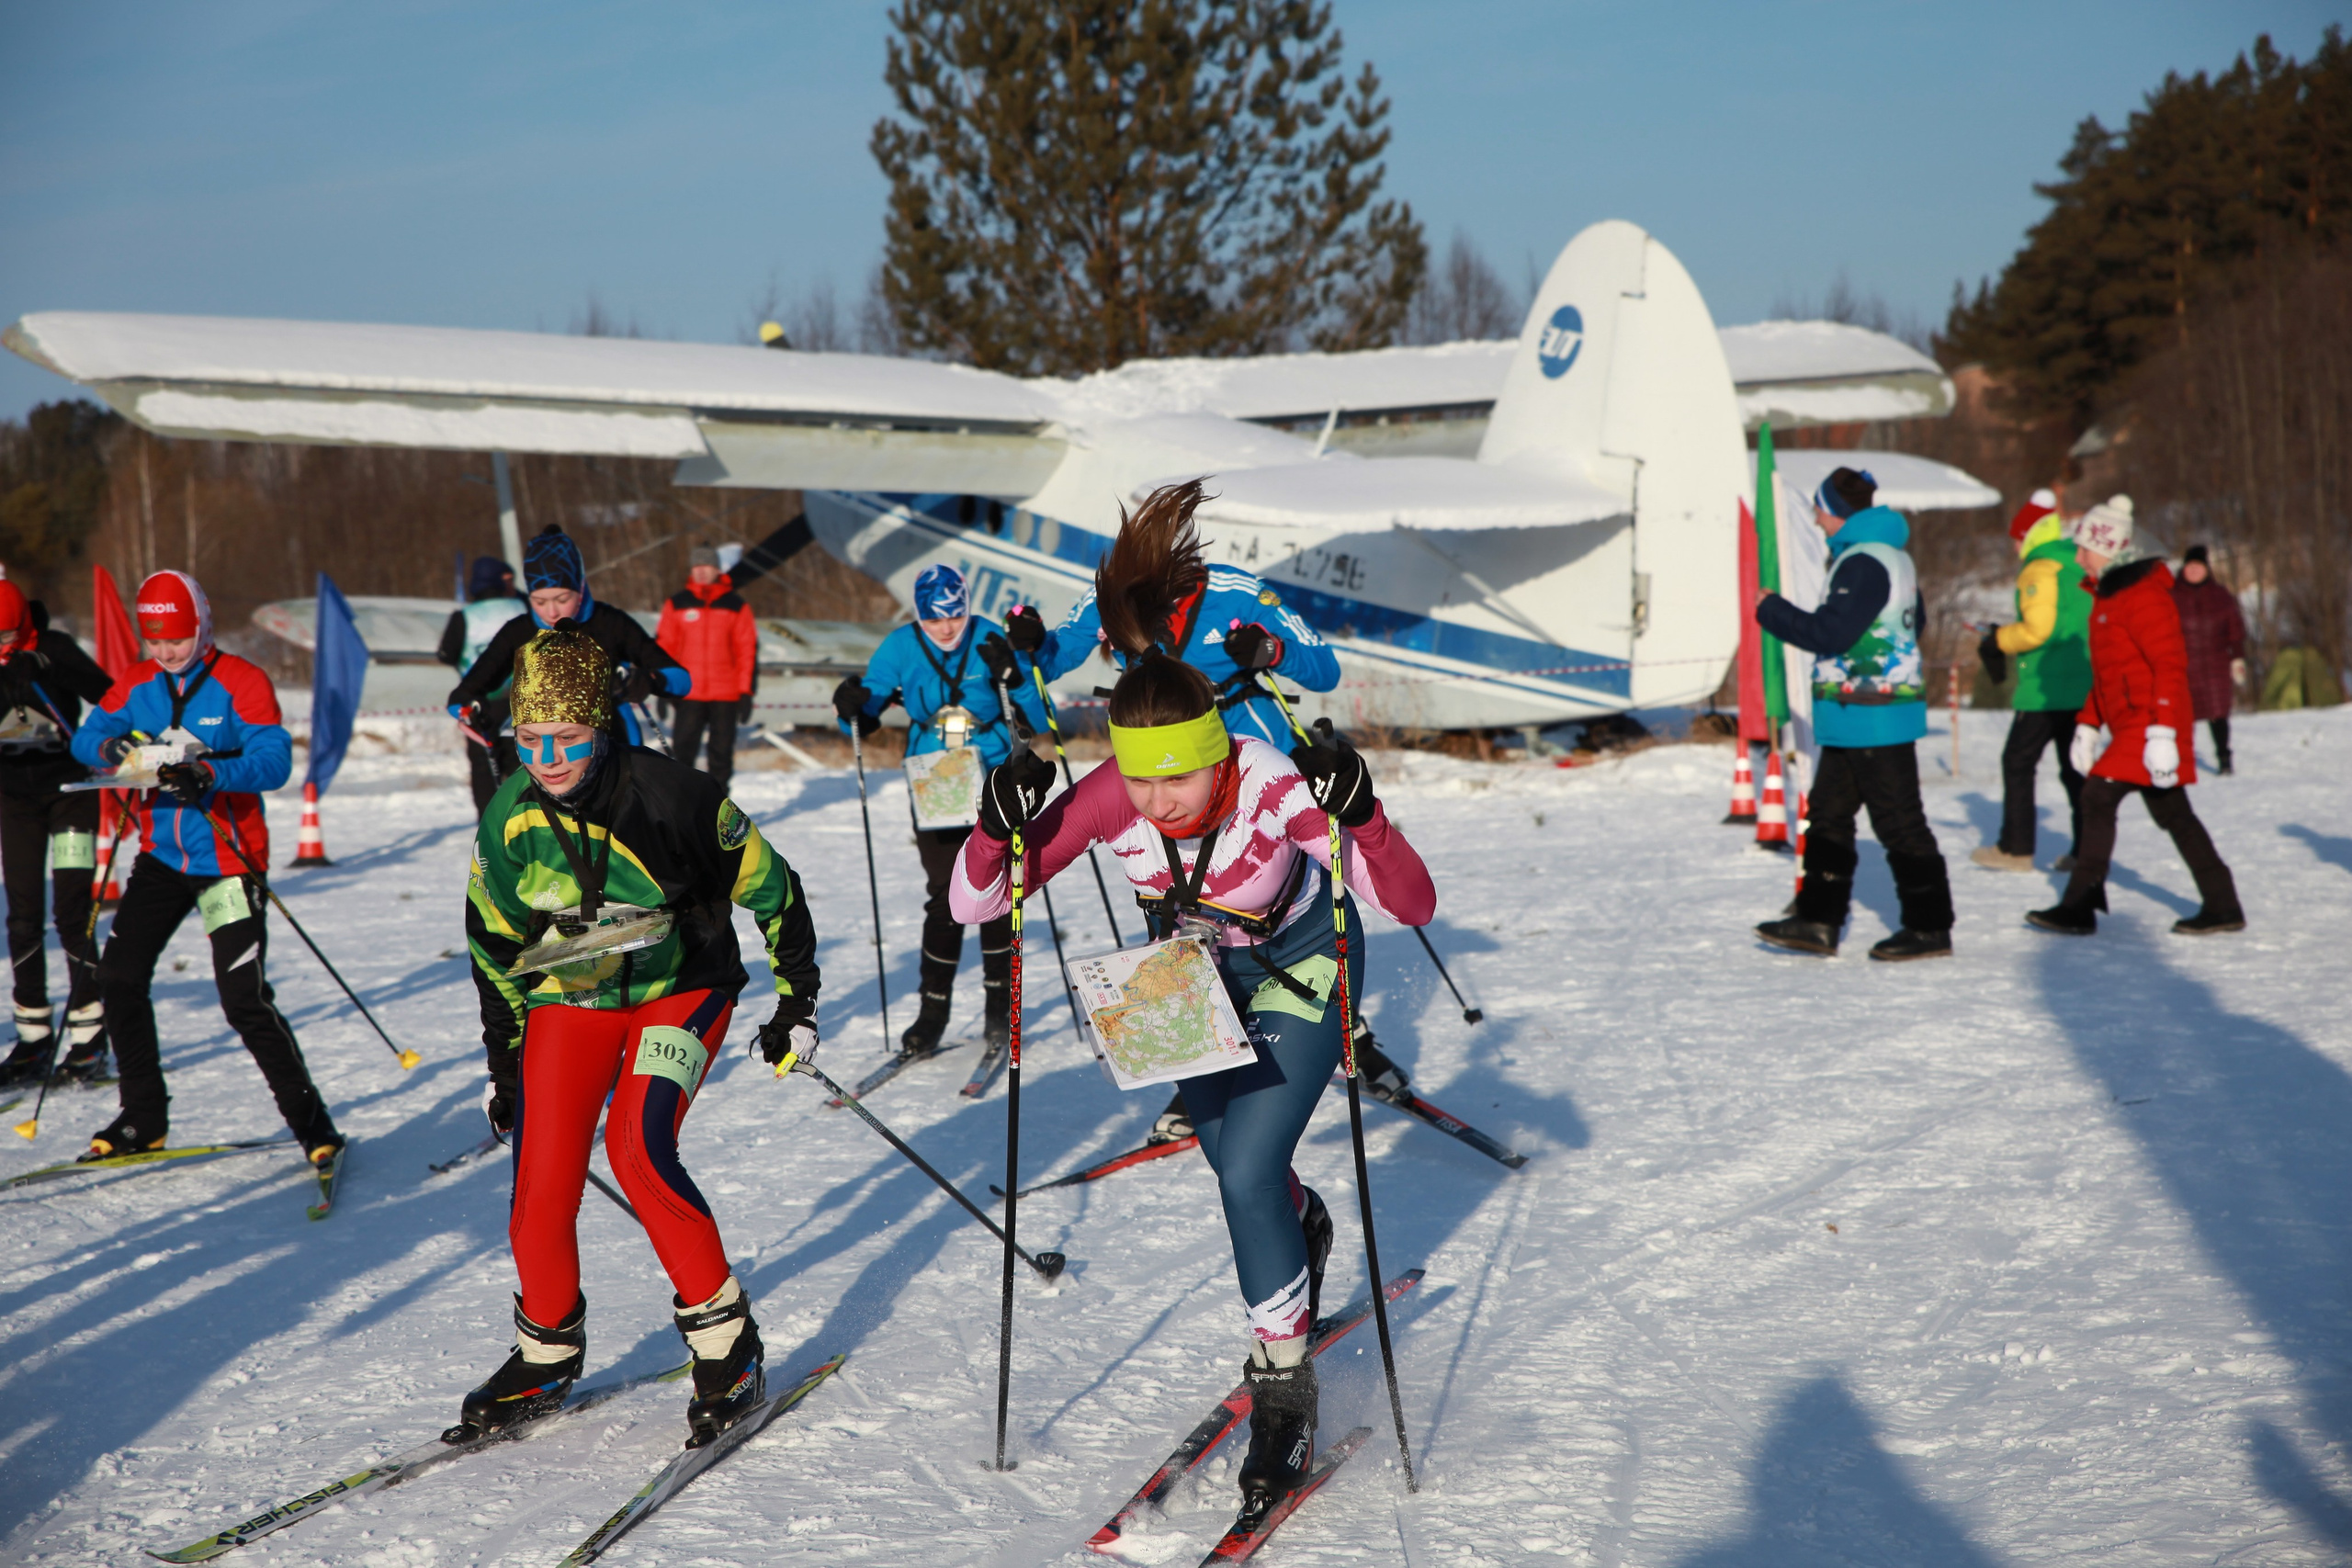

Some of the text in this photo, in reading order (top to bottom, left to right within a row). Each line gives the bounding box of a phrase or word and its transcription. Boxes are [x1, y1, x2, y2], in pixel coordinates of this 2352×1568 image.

[649, 1042, 697, 1077] 302.1
[1224, 1035, 1240, 1056] 301.1
[695, 1312, 729, 1325] SALOMON
[1250, 1371, 1294, 1383] SPINE
[713, 1424, 749, 1460] FISCHER
[236, 1481, 349, 1535] FISCHER
